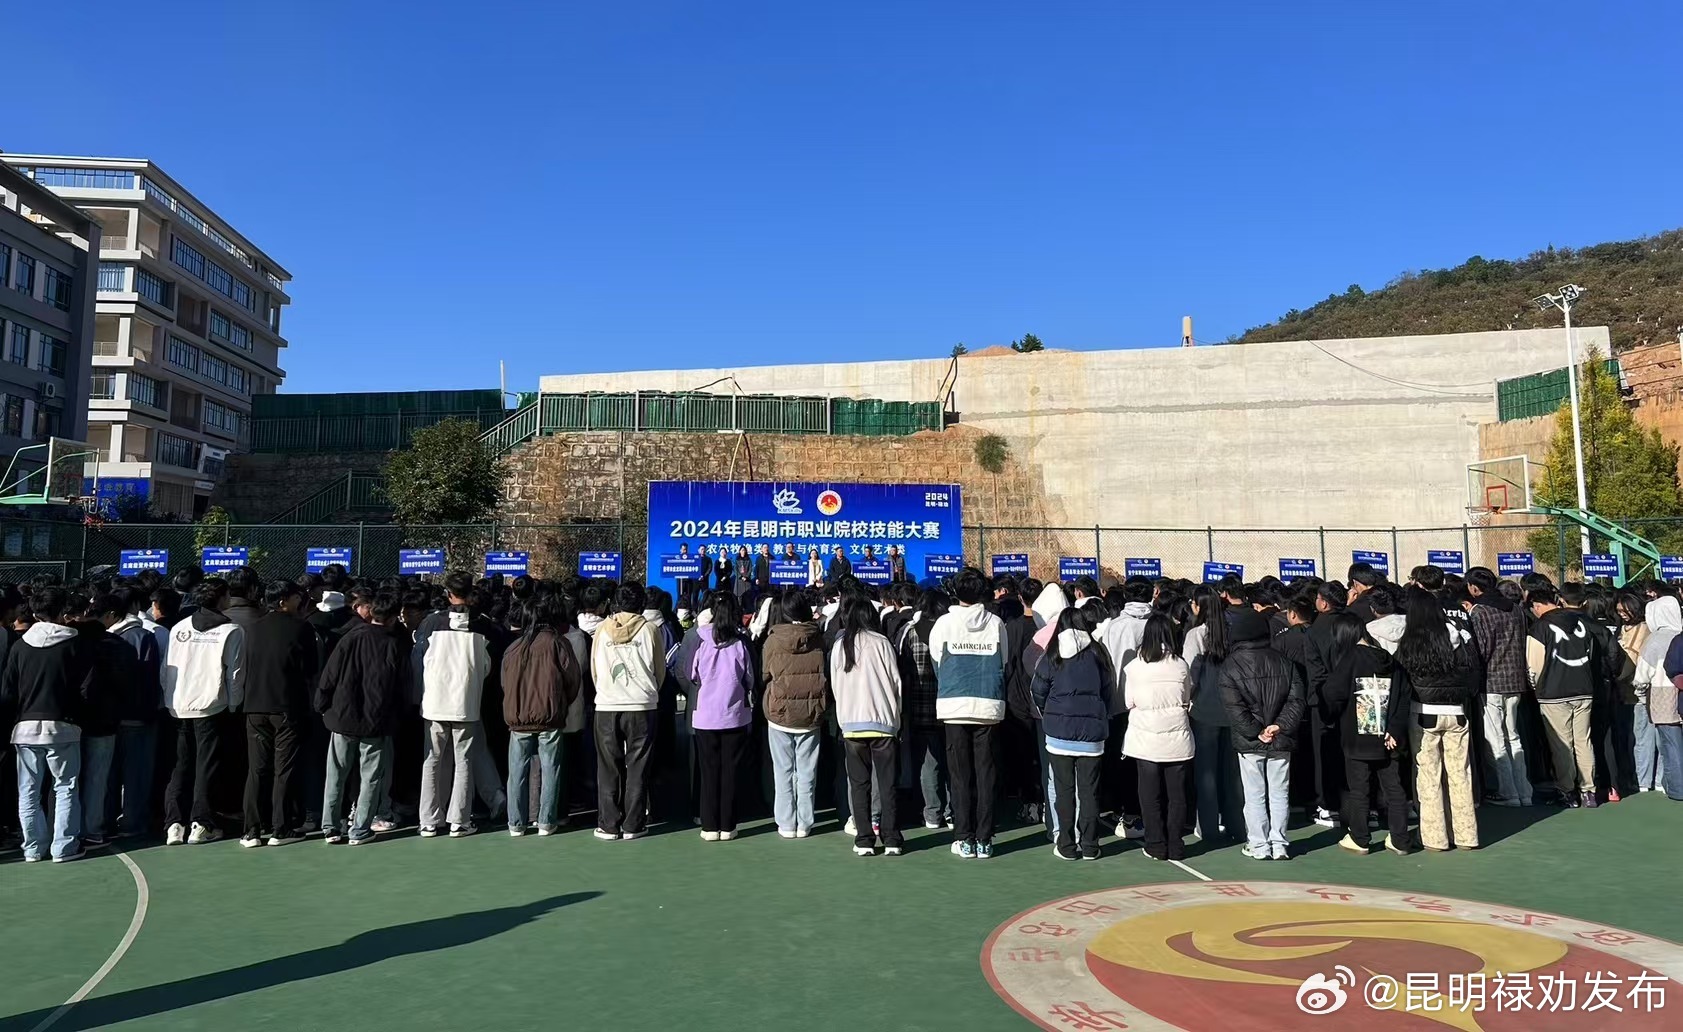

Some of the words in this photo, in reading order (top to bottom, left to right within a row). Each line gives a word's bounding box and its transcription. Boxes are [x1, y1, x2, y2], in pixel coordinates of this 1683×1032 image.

[925, 492, 949, 500] 2024
[670, 520, 940, 539] 2024年昆明市职业院校技能大赛
